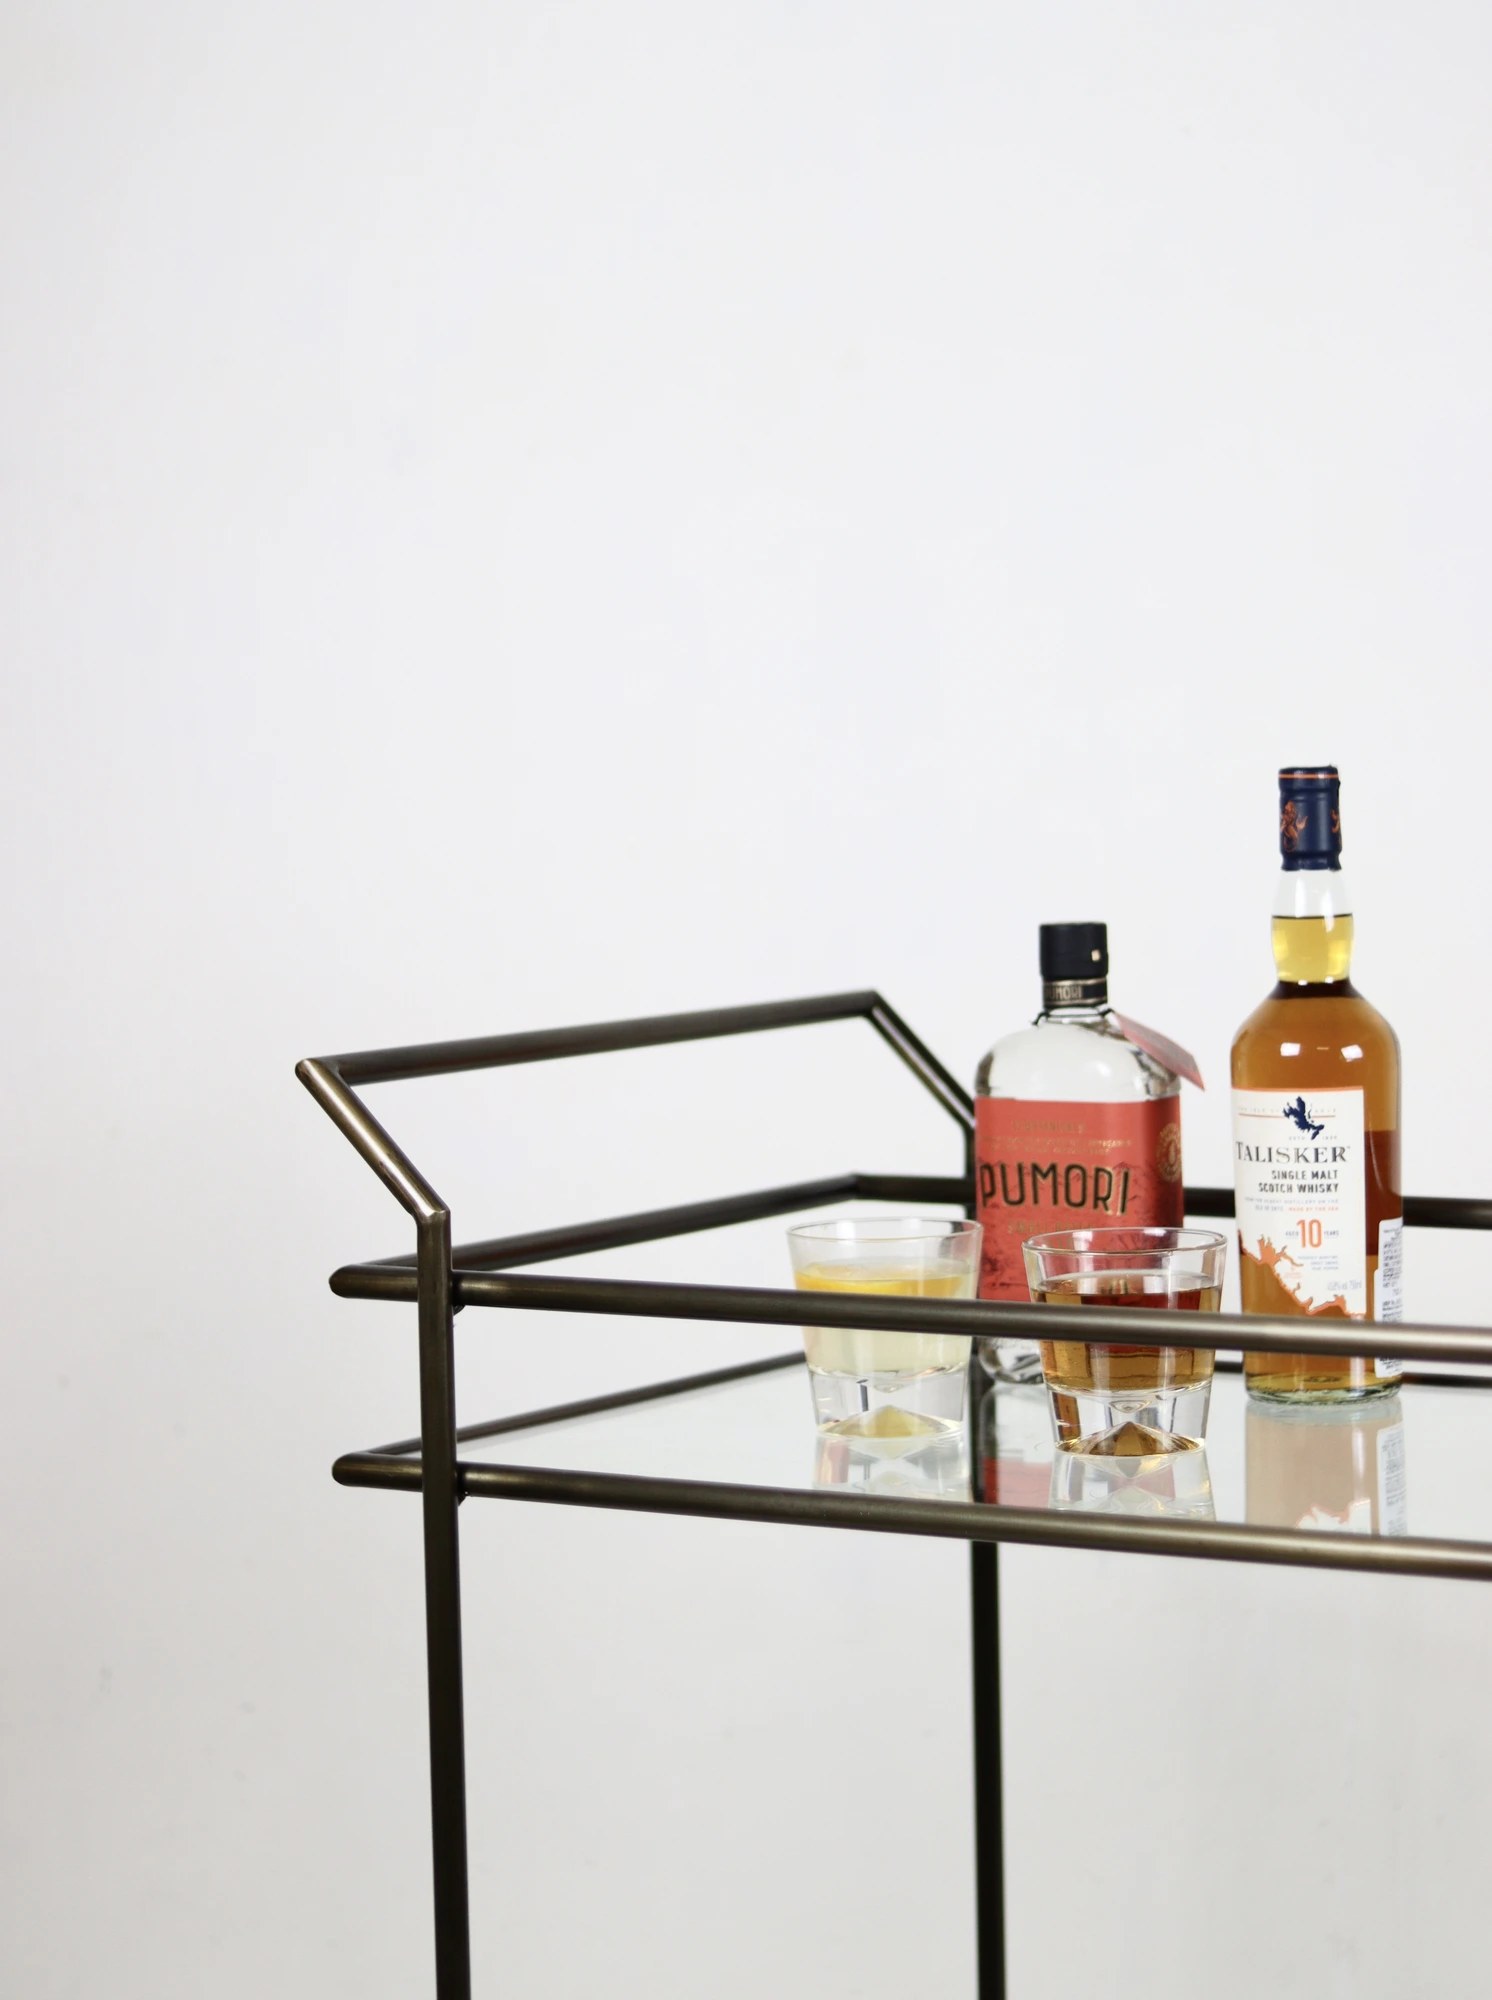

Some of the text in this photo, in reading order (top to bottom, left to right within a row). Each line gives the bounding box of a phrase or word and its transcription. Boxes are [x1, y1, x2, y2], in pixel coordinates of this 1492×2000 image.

[1234, 1140, 1347, 1164] TALISKER
[1271, 1169, 1339, 1181] SINGLE MALT
[979, 1162, 1130, 1215] PUMORI
[1258, 1182, 1340, 1194] SCOTCH WHISKY
[1296, 1218, 1322, 1249] 10
